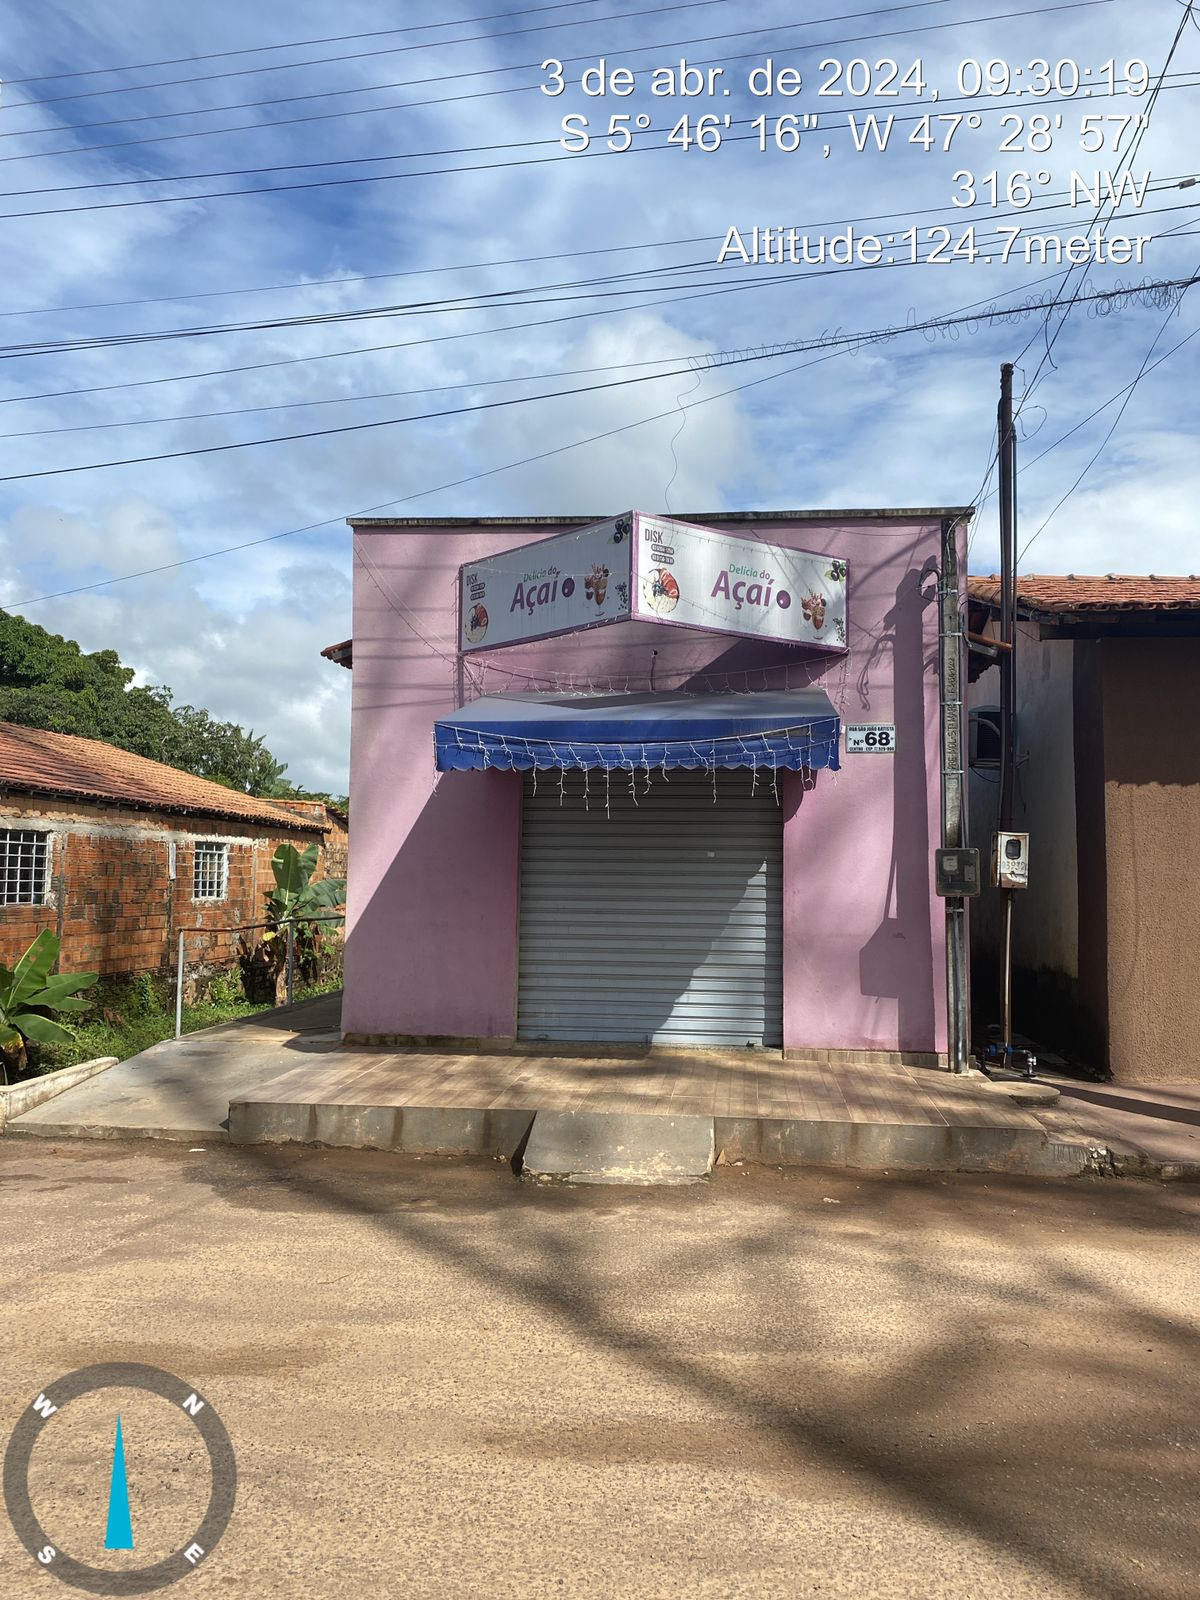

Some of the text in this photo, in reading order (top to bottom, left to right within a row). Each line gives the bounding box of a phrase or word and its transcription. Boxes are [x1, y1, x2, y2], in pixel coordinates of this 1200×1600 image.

[644, 527, 664, 545] DISK
[466, 572, 478, 586] DISK
[523, 565, 557, 583] Delícia do
[728, 562, 771, 580] Delícia do
[509, 569, 561, 615] Açaí
[710, 569, 775, 610] Açaí
[865, 732, 890, 746] 68
